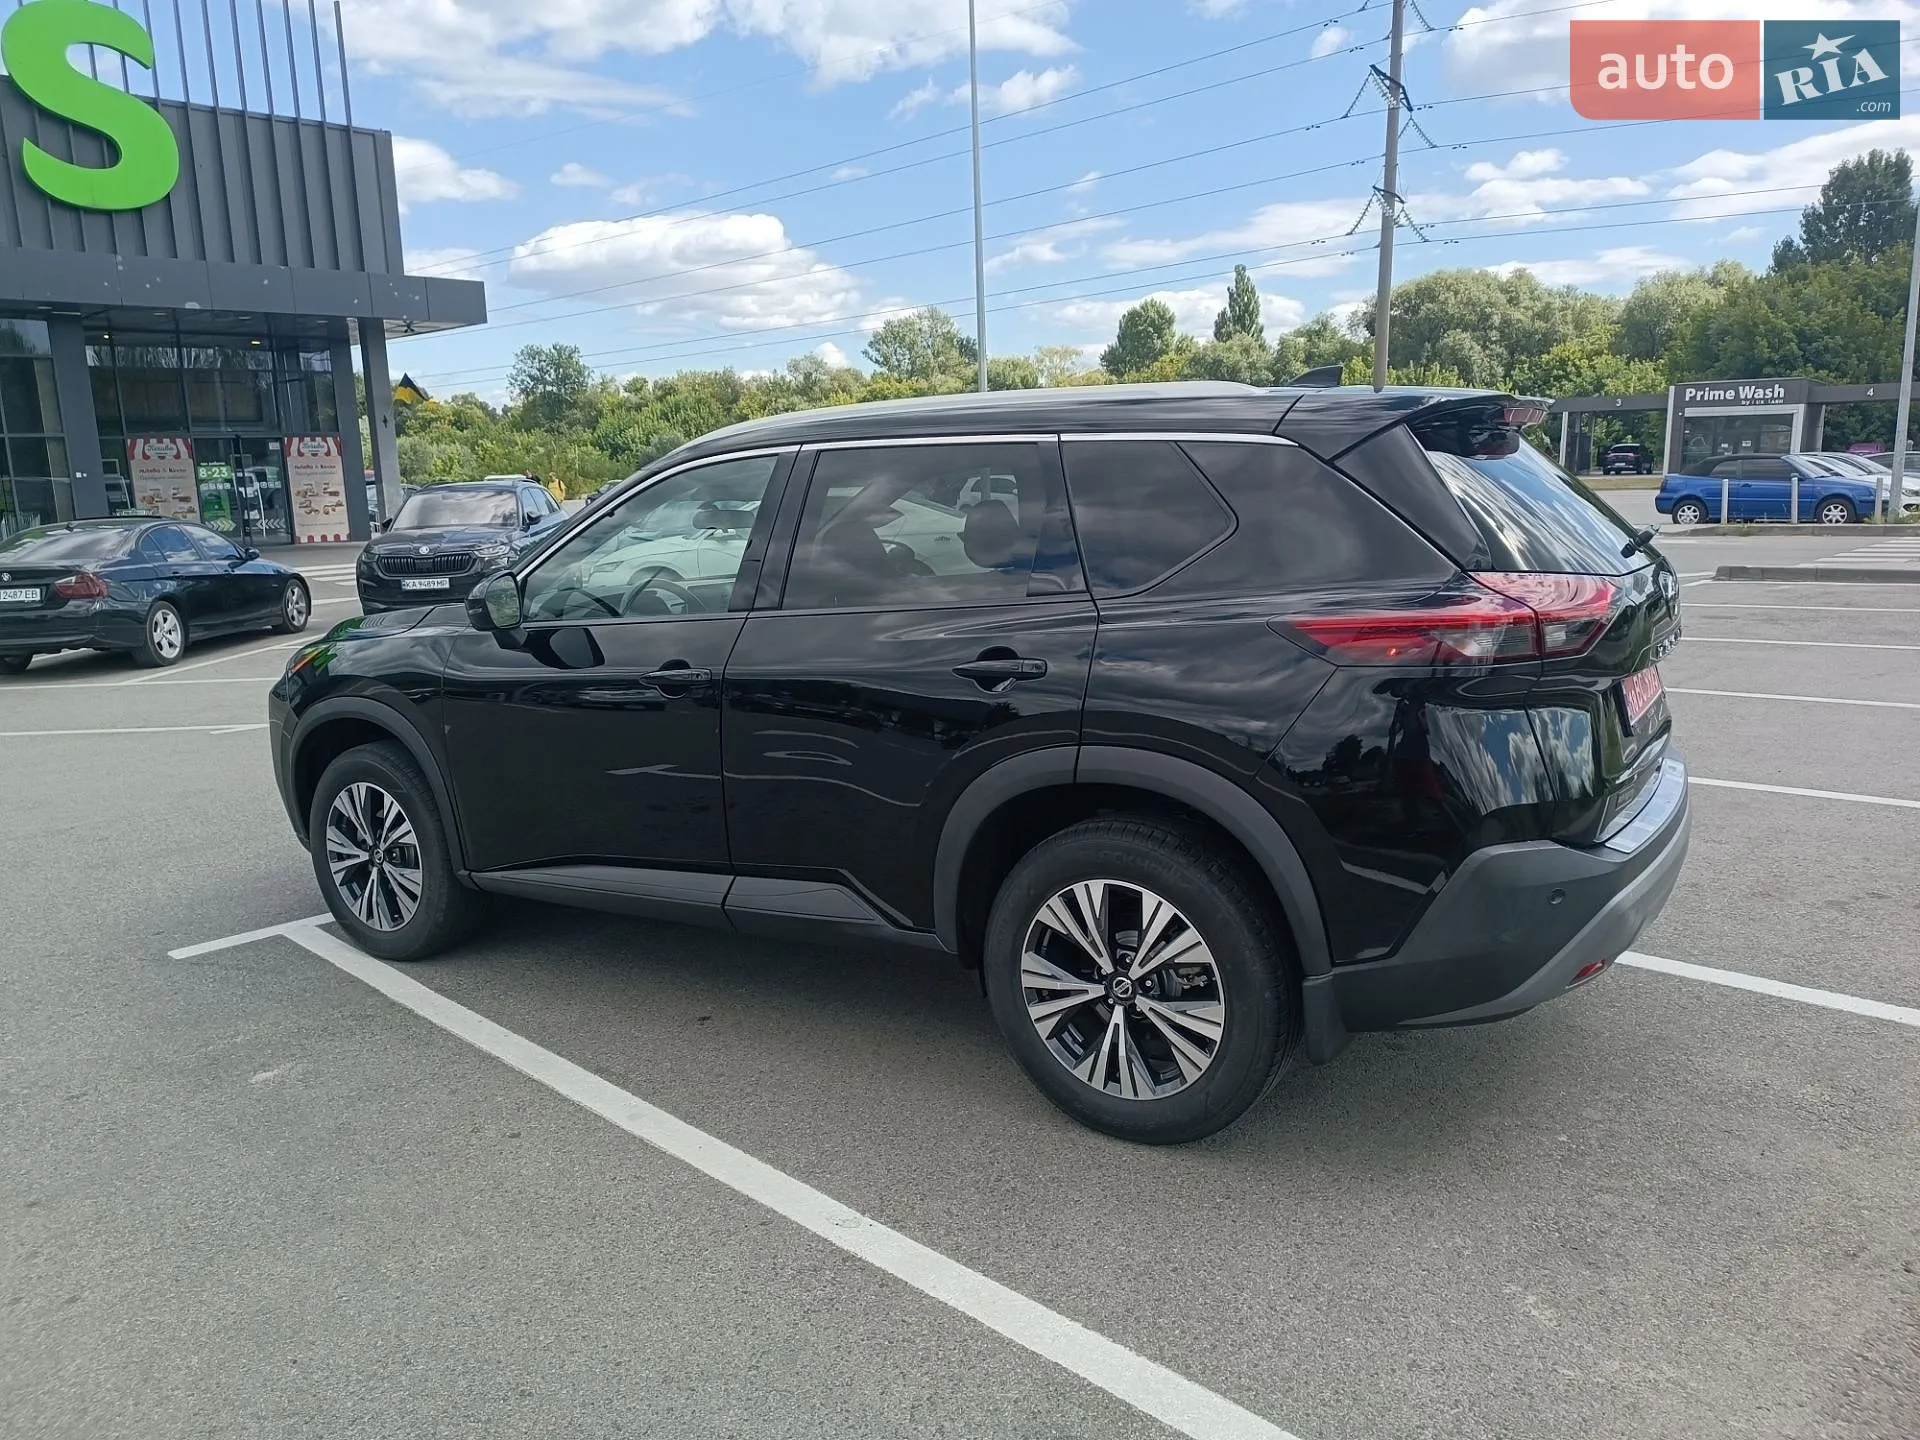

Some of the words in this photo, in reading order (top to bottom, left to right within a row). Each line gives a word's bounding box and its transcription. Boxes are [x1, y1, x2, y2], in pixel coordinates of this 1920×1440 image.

[1, 0, 180, 211] S
[1685, 386, 1736, 401] Prime
[1738, 384, 1785, 400] Wash
[1866, 387, 1875, 397] 4
[1615, 398, 1622, 408] 3
[199, 467, 228, 478] 8-23
[3, 590, 22, 600] 2487
[25, 589, 38, 599] EB
